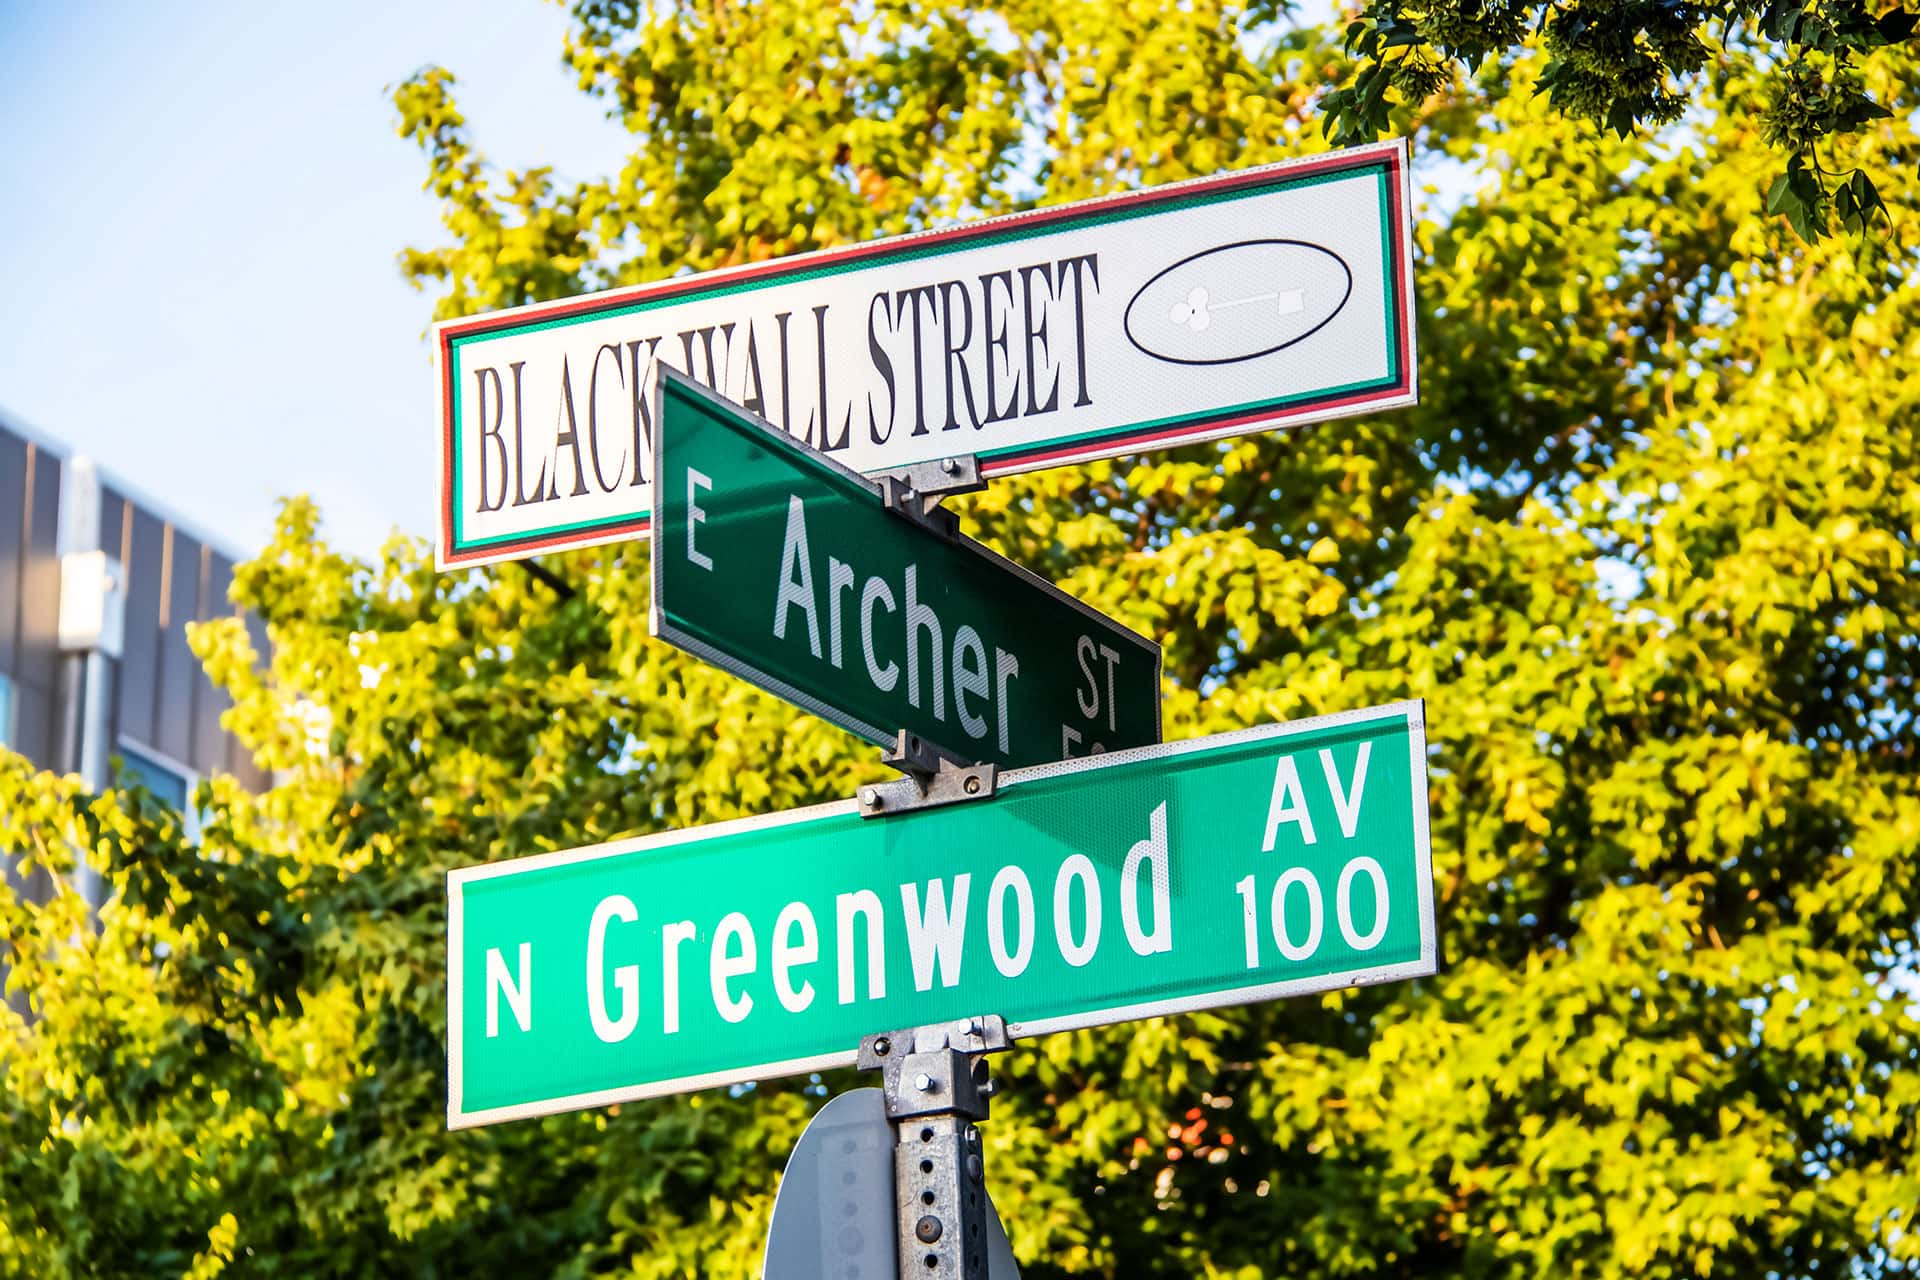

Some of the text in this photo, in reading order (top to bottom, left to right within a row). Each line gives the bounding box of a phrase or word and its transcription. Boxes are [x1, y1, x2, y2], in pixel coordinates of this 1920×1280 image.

[474, 336, 662, 513] BLACK
[867, 252, 1100, 446] STREET
[686, 466, 1121, 755] E Archer ST
[486, 741, 1373, 1043] N Greenwood AV
[1236, 856, 1390, 969] 100
